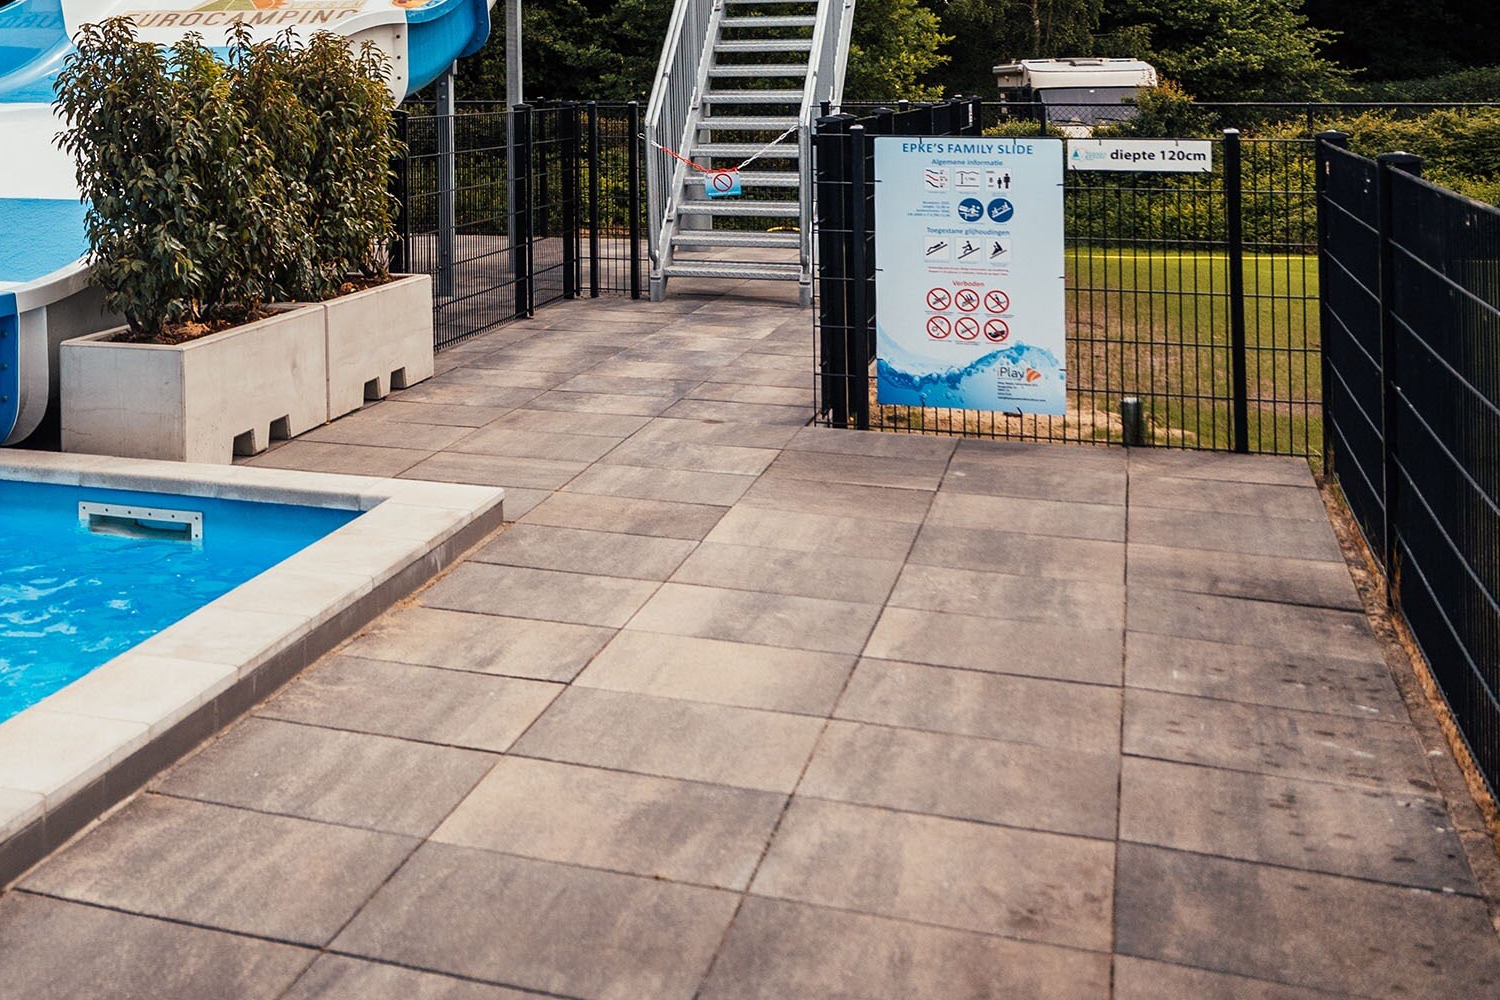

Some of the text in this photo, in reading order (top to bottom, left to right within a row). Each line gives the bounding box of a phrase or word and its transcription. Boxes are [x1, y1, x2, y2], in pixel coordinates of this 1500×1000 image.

[128, 9, 358, 28] UROCAMPIN
[948, 143, 993, 154] FAMILY
[997, 145, 1033, 155] SLIDE
[1110, 149, 1156, 163] diepte
[1160, 150, 1207, 161] 120cm
[931, 159, 965, 167] Algemene
[926, 227, 1010, 237] Toegestane glijhoudingen
[952, 280, 985, 288] Verboden
[997, 366, 1025, 380] iPlay
